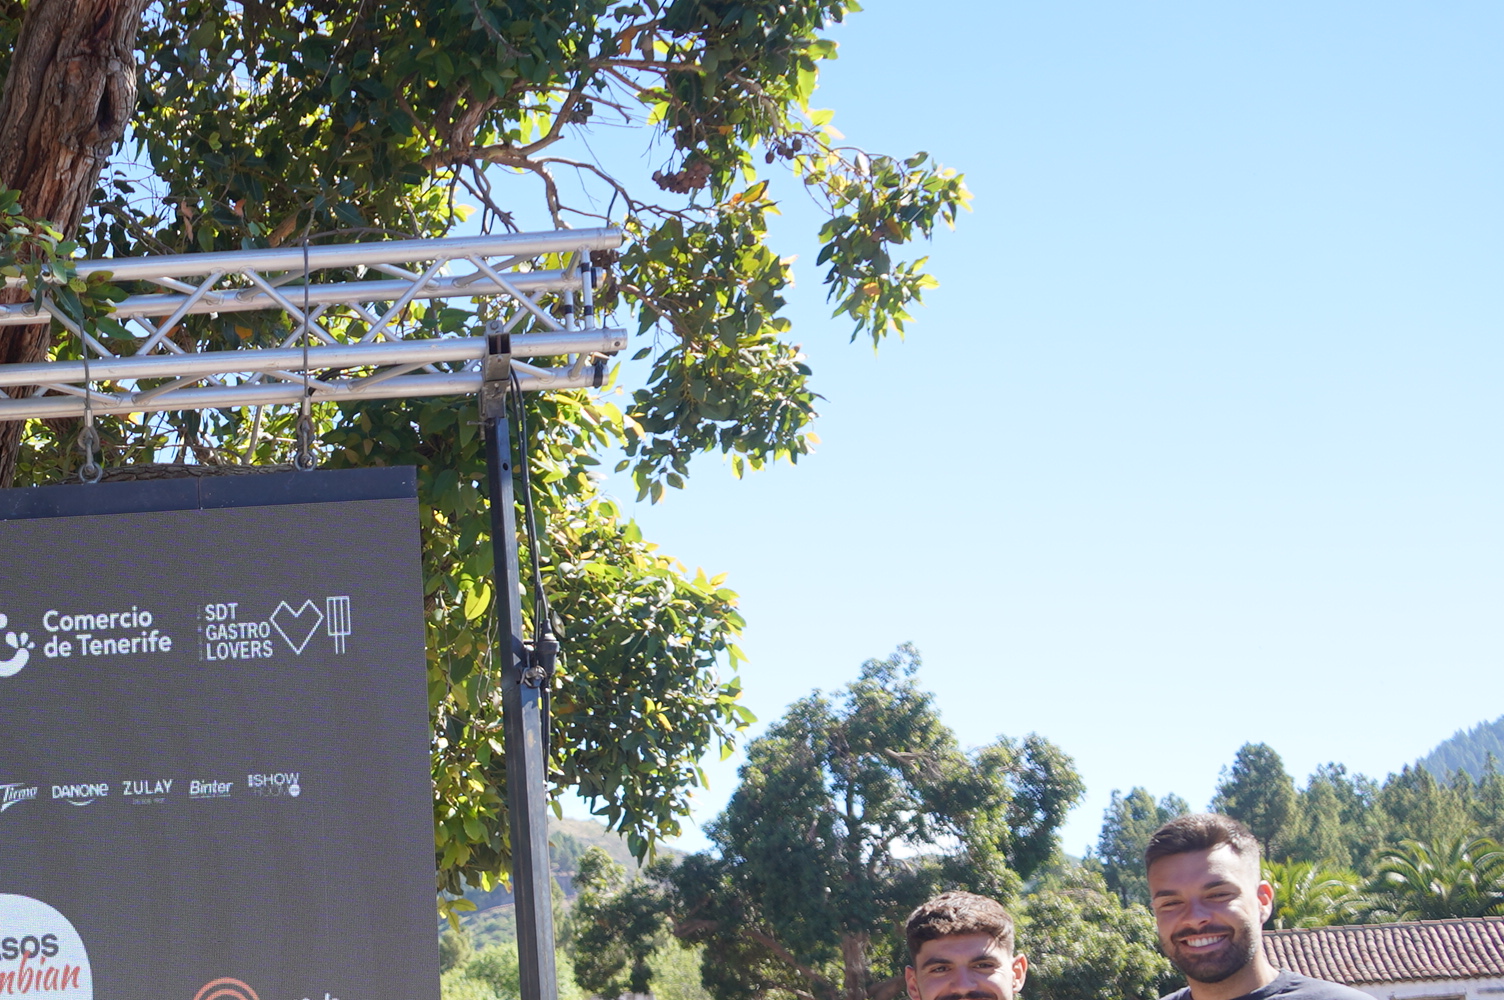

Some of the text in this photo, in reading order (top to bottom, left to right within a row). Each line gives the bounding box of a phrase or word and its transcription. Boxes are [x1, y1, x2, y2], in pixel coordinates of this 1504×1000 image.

[43, 605, 153, 632] Comercio
[205, 602, 239, 621] SDT
[205, 622, 271, 641] GASTRO
[44, 635, 71, 658] de
[76, 630, 172, 656] Tenerife
[206, 640, 273, 661] LOVERS
[122, 779, 173, 795] ZULAY
[189, 780, 234, 795] Binter
